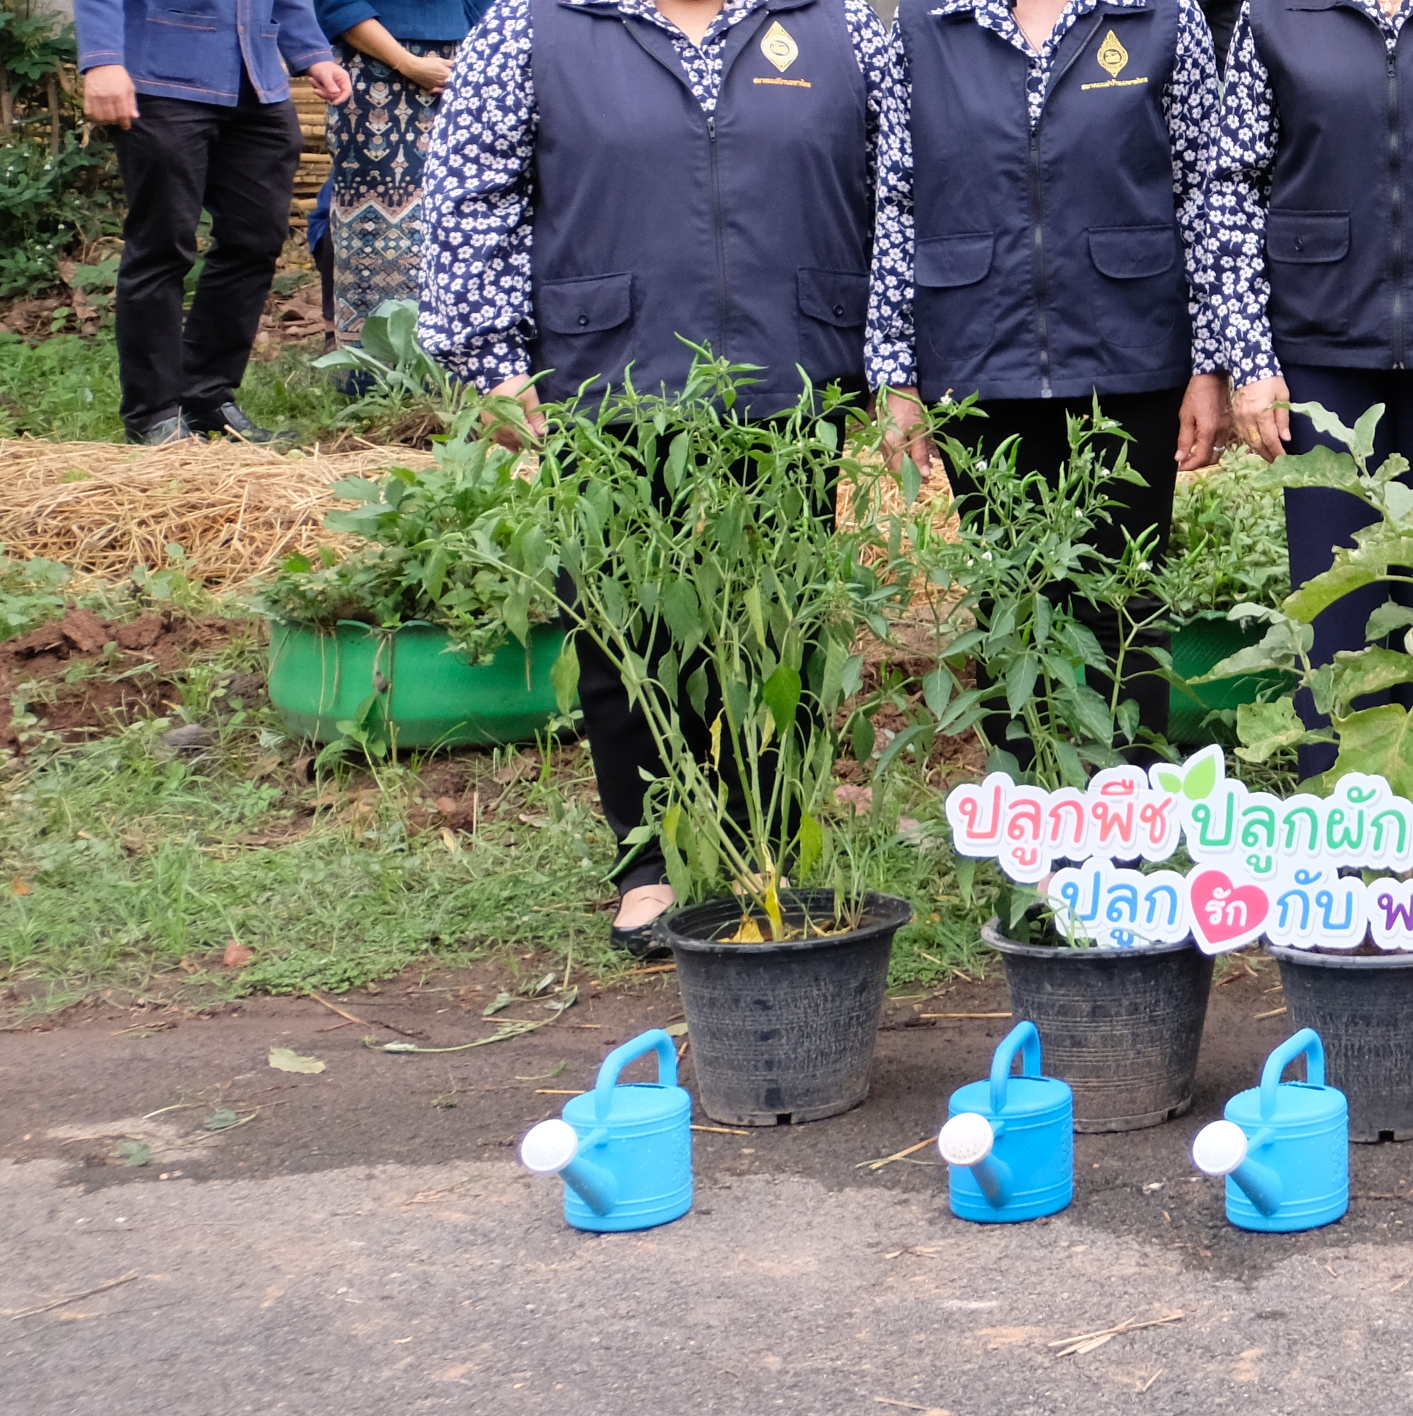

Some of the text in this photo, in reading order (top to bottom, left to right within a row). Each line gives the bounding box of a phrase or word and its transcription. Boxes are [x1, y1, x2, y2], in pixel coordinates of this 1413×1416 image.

[957, 778, 1408, 875] ปลูกพืช ปลูกผัก
[1061, 871, 1178, 947] ปลูก
[1205, 888, 1248, 929] รัก
[1277, 868, 1354, 931] กับ
